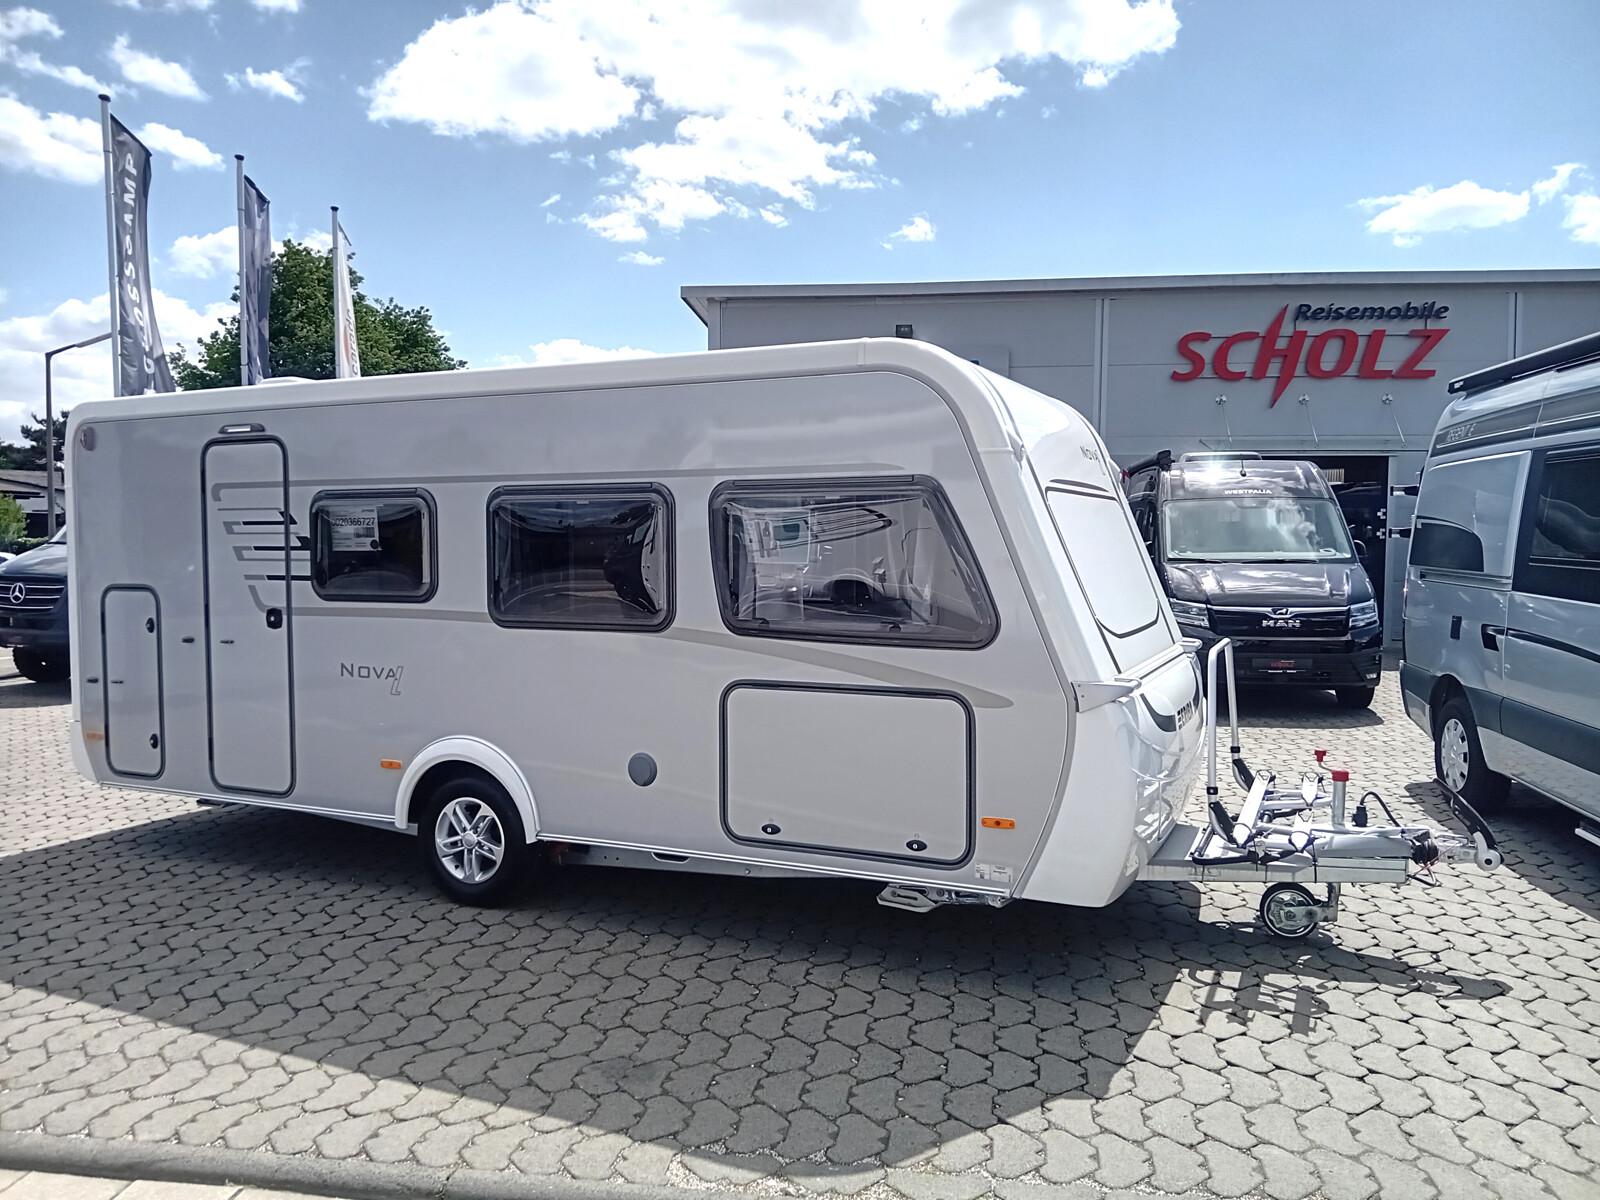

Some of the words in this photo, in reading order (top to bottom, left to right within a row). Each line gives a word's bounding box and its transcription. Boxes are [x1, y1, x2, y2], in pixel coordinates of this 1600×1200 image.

[1294, 302, 1451, 322] Reisemobile
[1170, 304, 1451, 409] SCHOLZ
[1262, 619, 1301, 627] MAN
